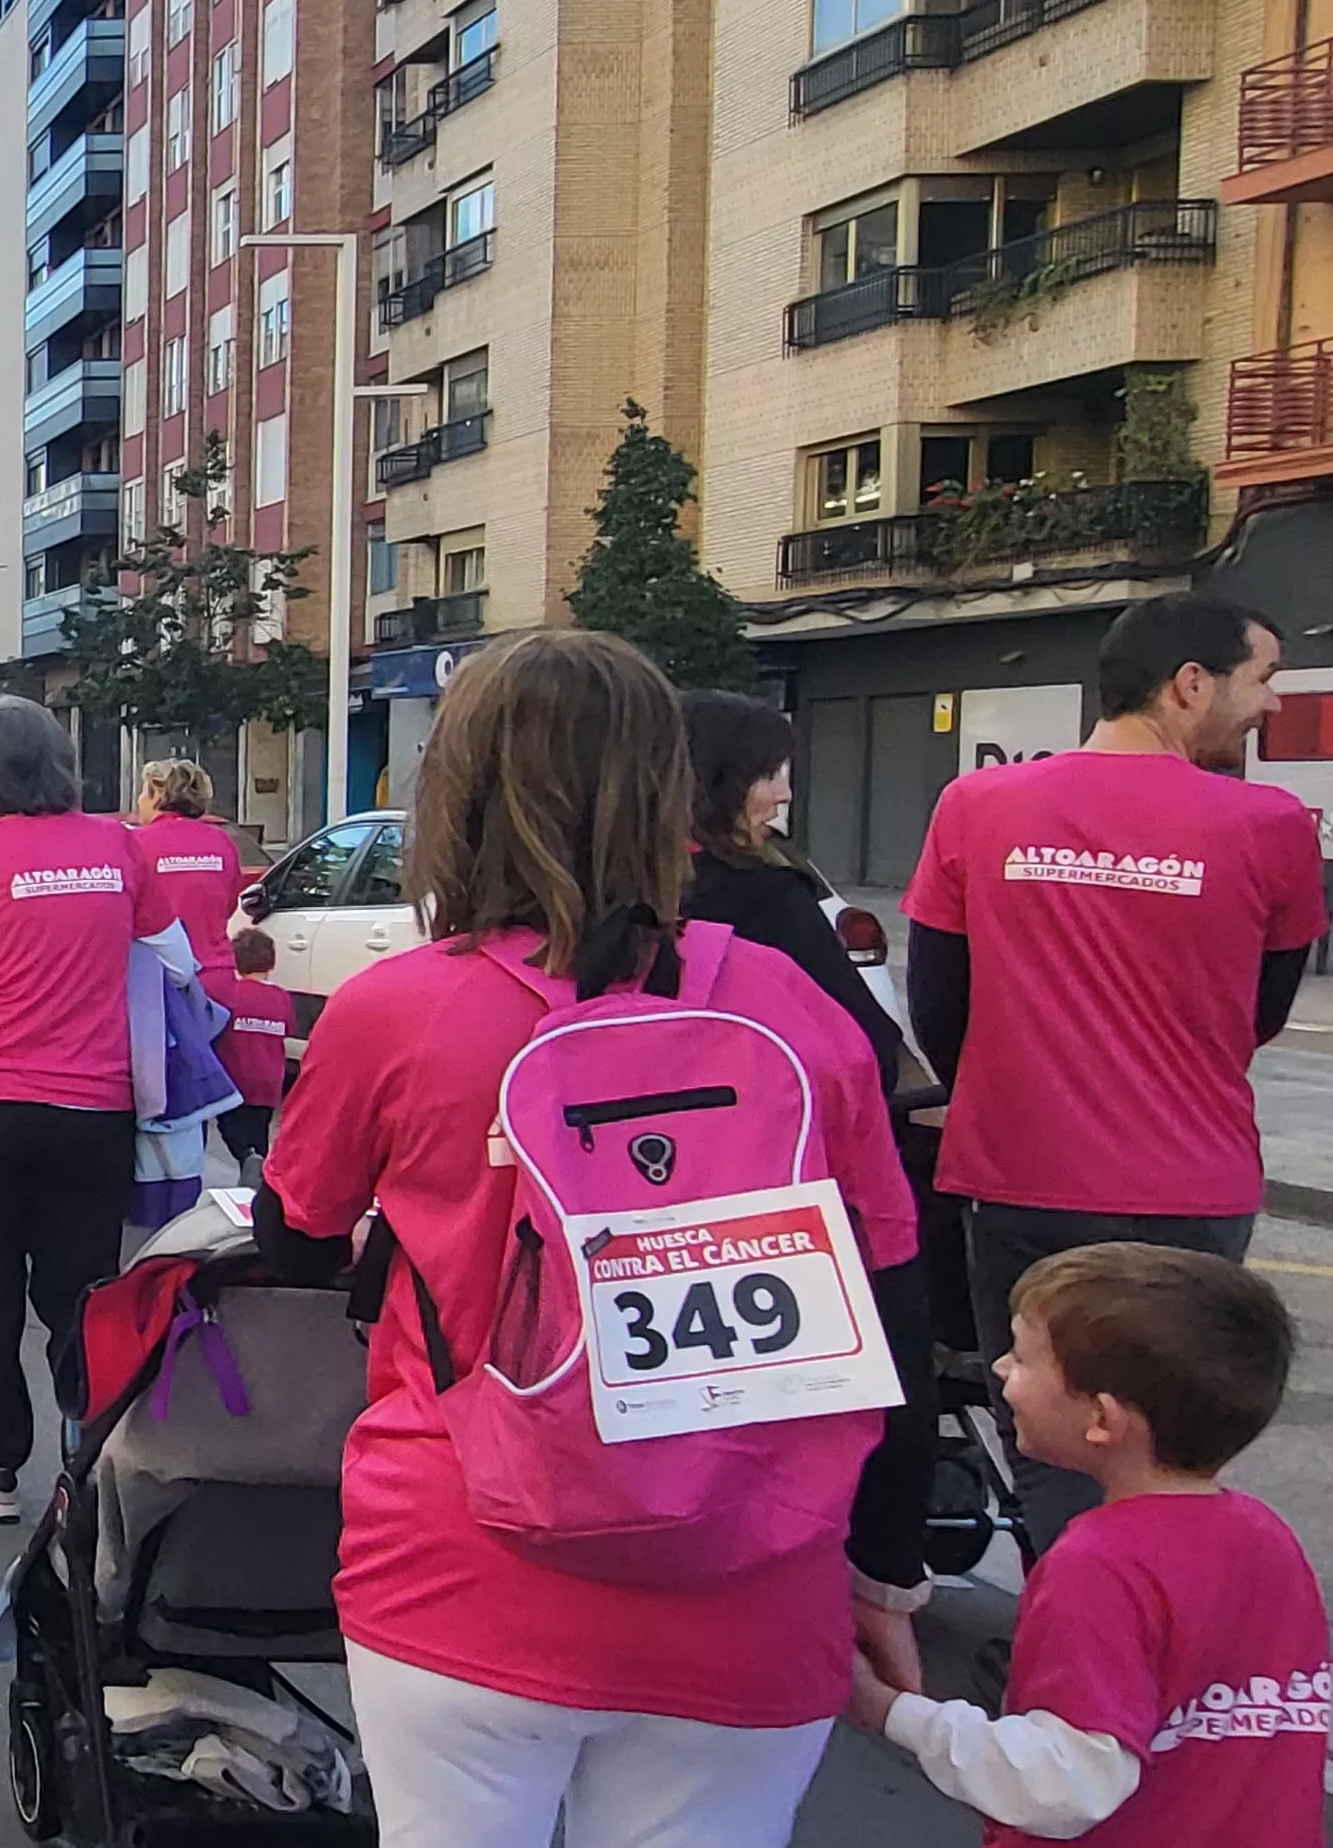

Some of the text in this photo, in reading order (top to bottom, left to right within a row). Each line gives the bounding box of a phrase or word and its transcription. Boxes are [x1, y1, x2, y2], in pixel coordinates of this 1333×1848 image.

[13, 863, 121, 888] ALTOARAGÓN
[1006, 846, 1205, 878] ALTOARAGÓN
[1023, 866, 1180, 892] SUPERMERCADOS
[637, 1228, 714, 1252] HUESCA
[594, 1231, 815, 1279] CONTRA EL CÁNCER
[613, 1272, 801, 1371] 349
